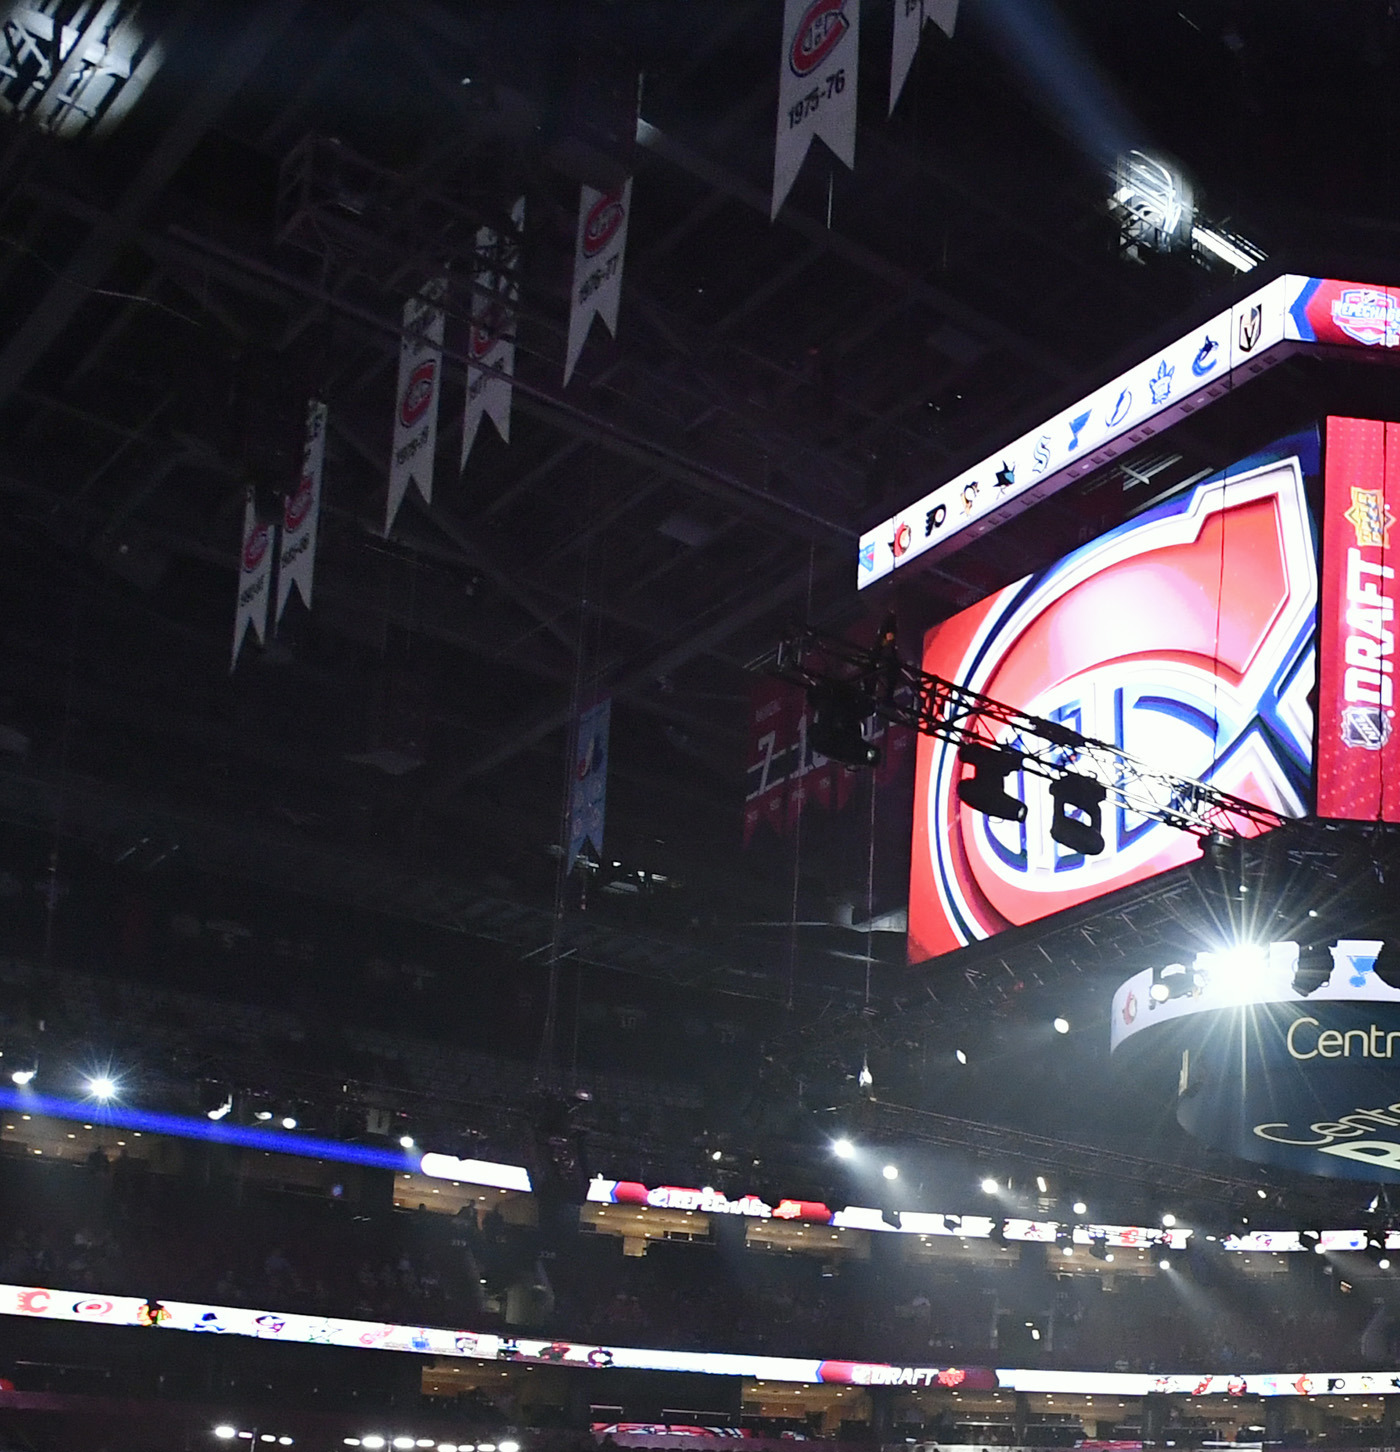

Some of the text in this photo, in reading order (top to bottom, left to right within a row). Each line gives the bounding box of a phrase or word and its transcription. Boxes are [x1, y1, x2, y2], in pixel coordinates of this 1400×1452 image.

[789, 69, 845, 129] 1975-76
[1344, 547, 1395, 707] DRAFT
[871, 1367, 938, 1388] DRAFT
